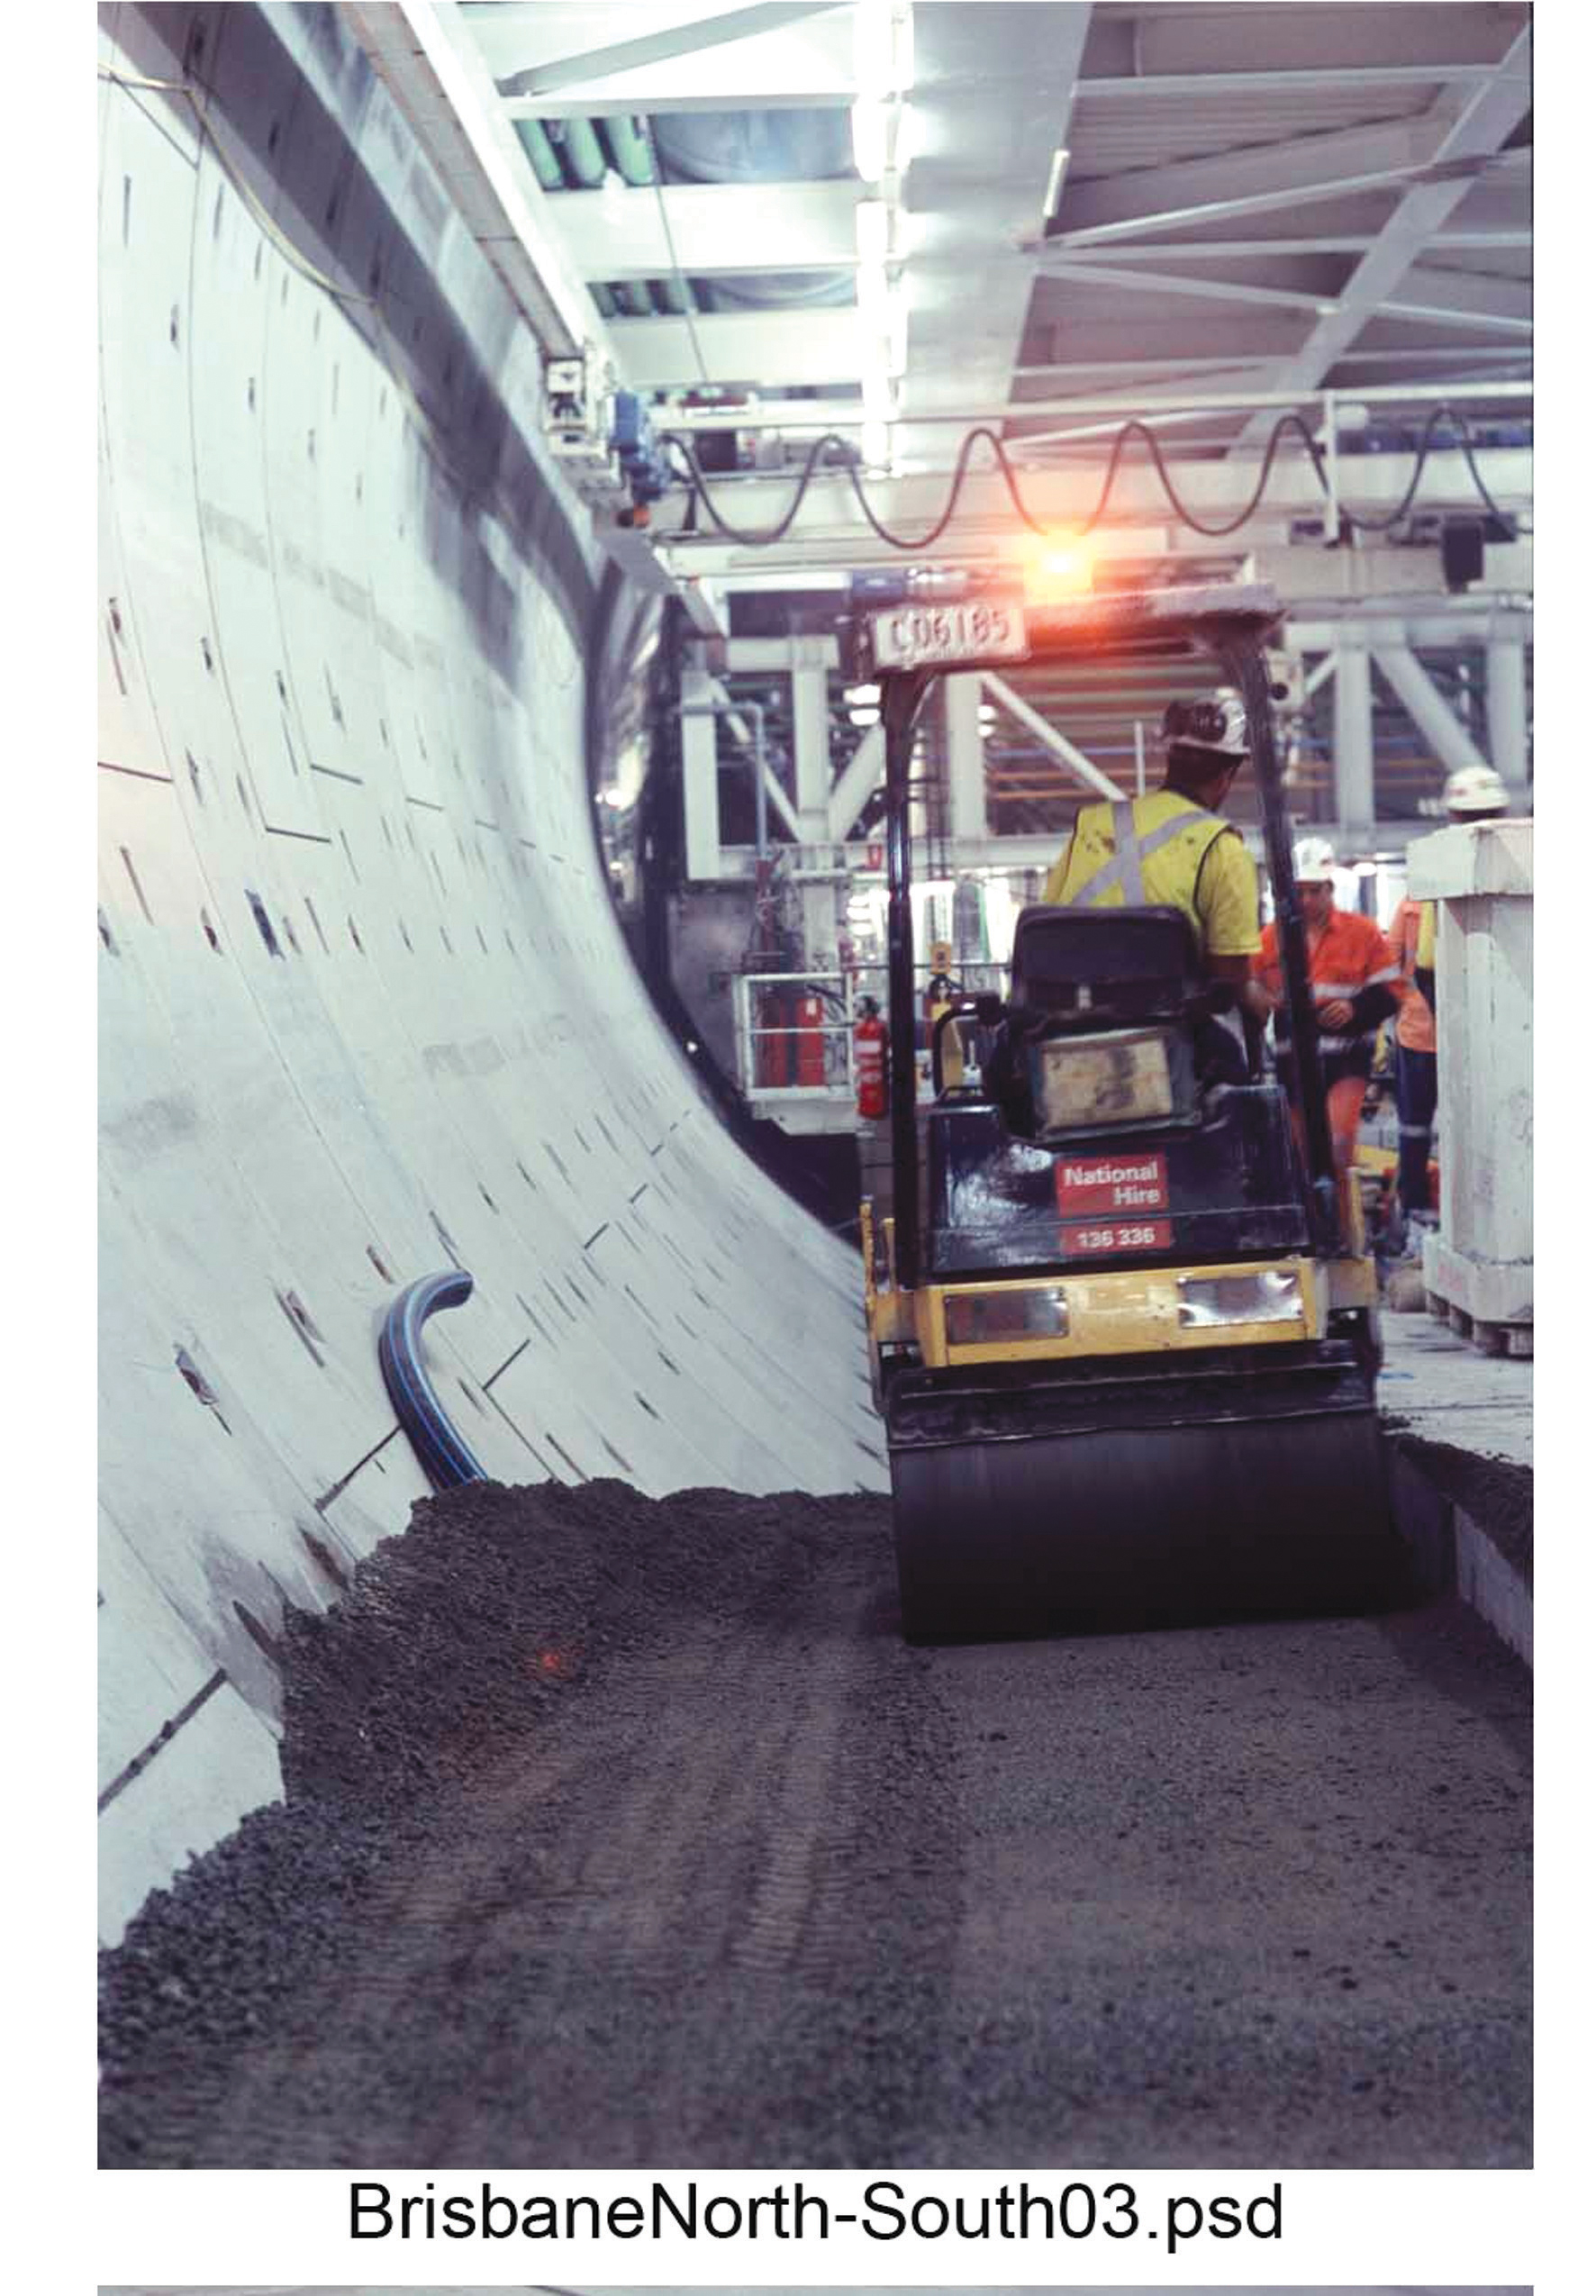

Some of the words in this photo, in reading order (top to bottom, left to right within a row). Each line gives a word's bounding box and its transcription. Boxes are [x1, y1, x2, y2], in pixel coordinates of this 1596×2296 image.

[1063, 1161, 1158, 1186] National
[1113, 1185, 1160, 1205] Hire
[1077, 1230, 1113, 1248] 136
[1118, 1227, 1155, 1245] 336
